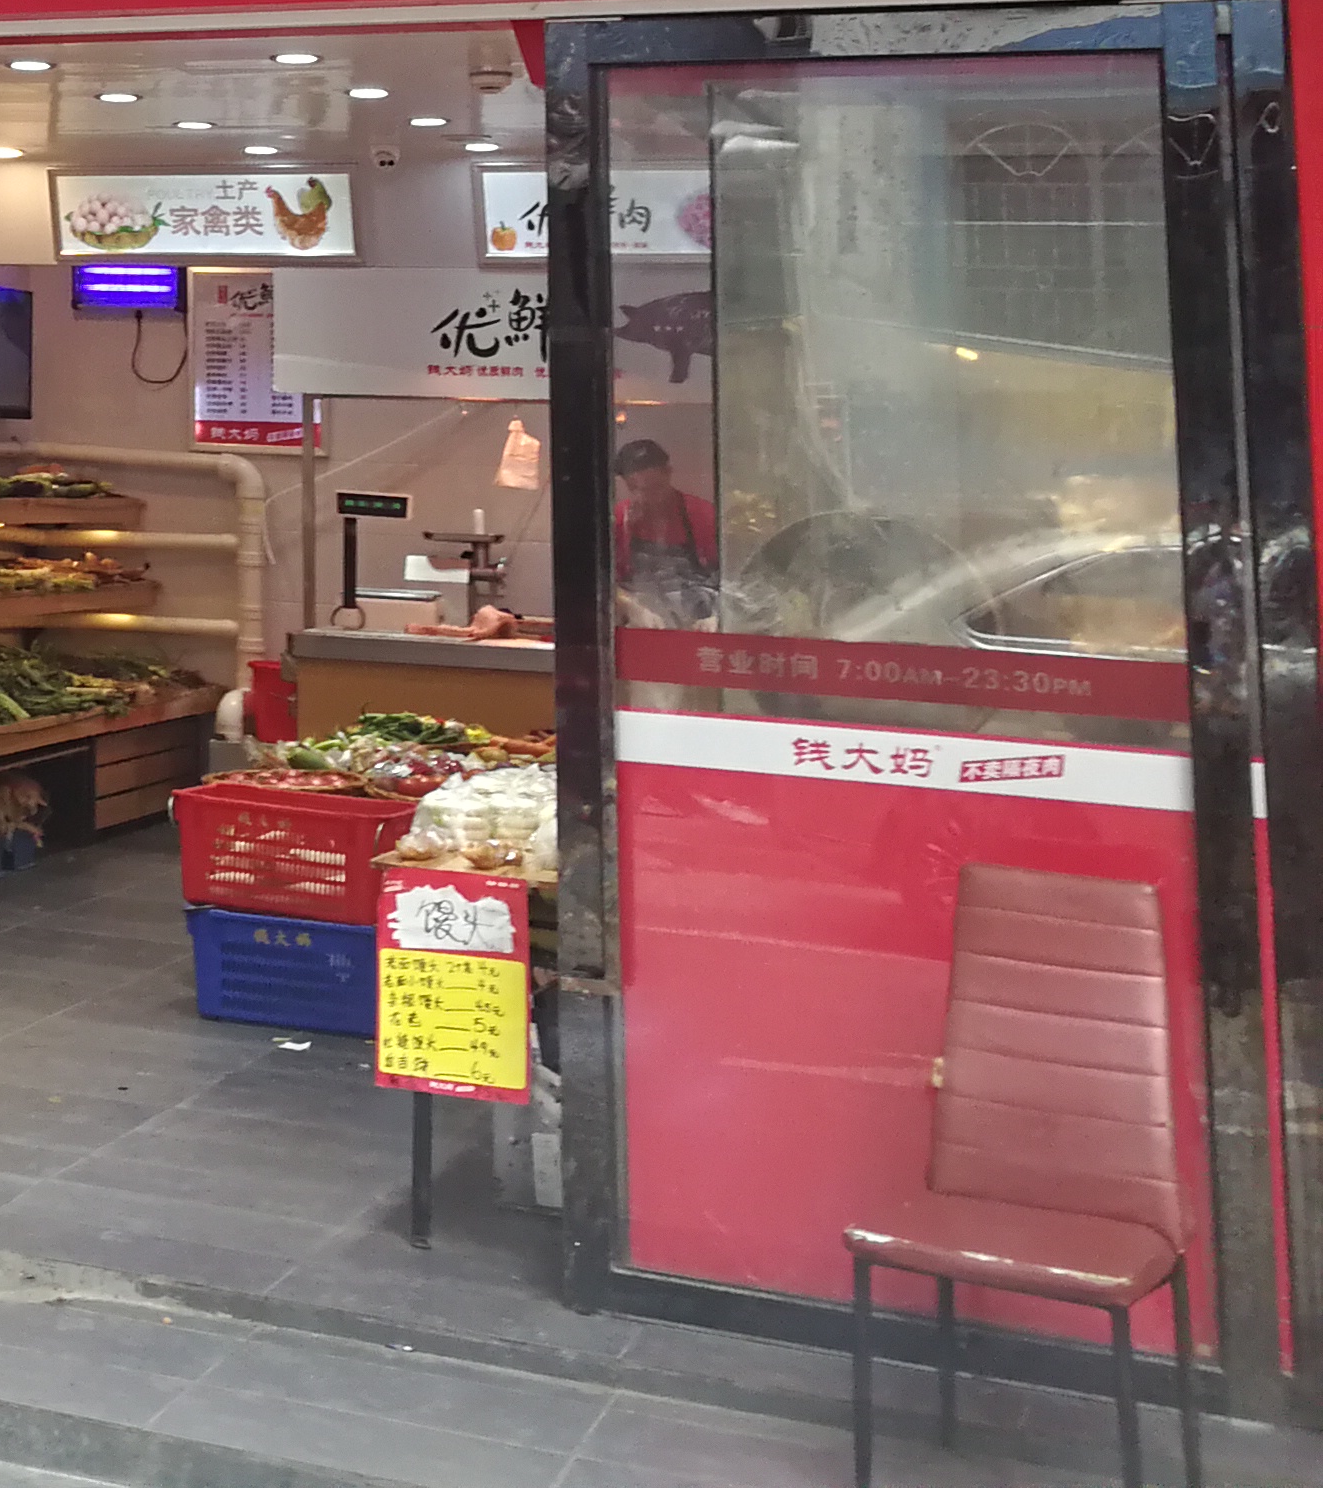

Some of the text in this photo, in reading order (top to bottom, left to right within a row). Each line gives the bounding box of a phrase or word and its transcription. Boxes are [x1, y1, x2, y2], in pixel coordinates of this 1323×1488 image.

[215, 179, 258, 201] 土产
[168, 205, 264, 237] 家禽类
[696, 646, 819, 680] 营业时间
[791, 737, 1062, 782] 钱大妈 不卖隔夜肉
